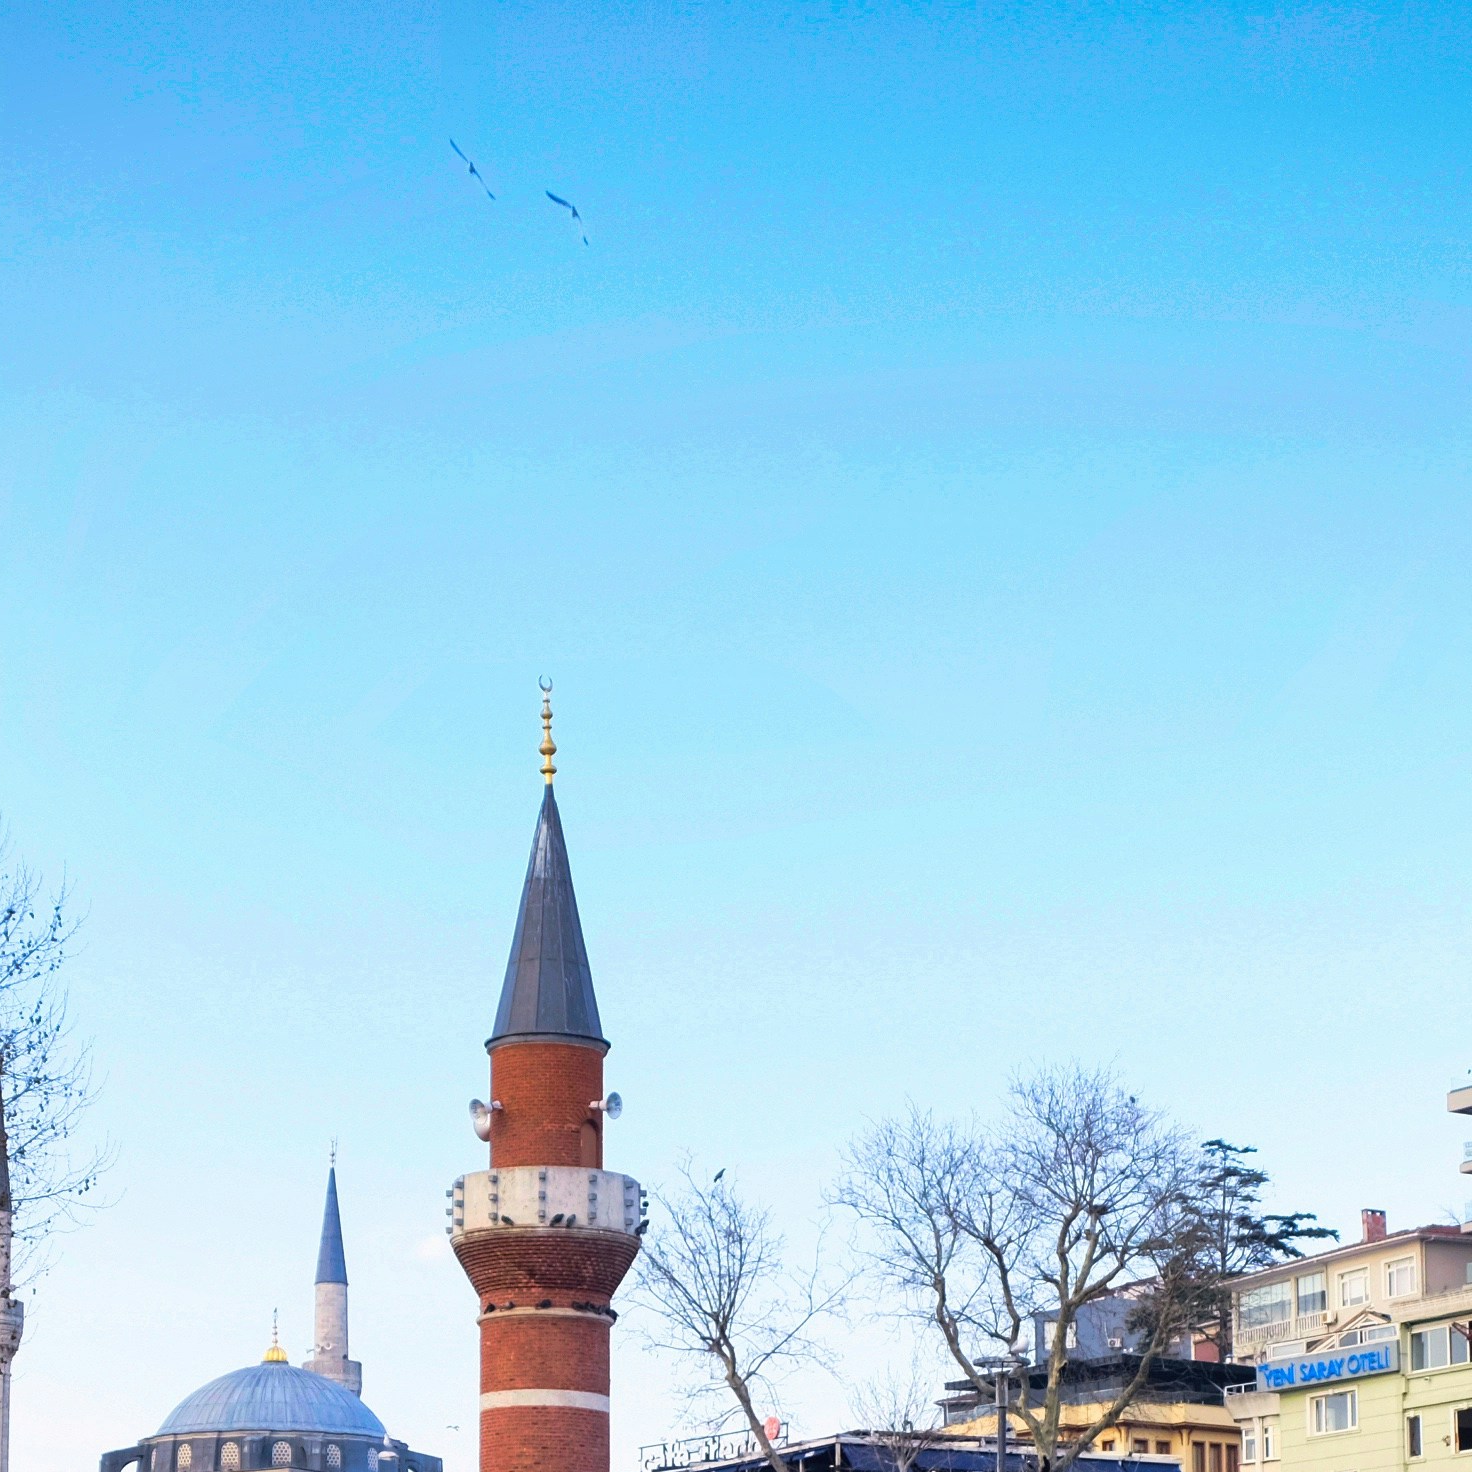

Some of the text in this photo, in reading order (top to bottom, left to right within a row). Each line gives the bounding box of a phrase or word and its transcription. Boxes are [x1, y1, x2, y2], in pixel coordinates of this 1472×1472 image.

[1265, 1345, 1390, 1387] YENİ SARAY OTELİ
